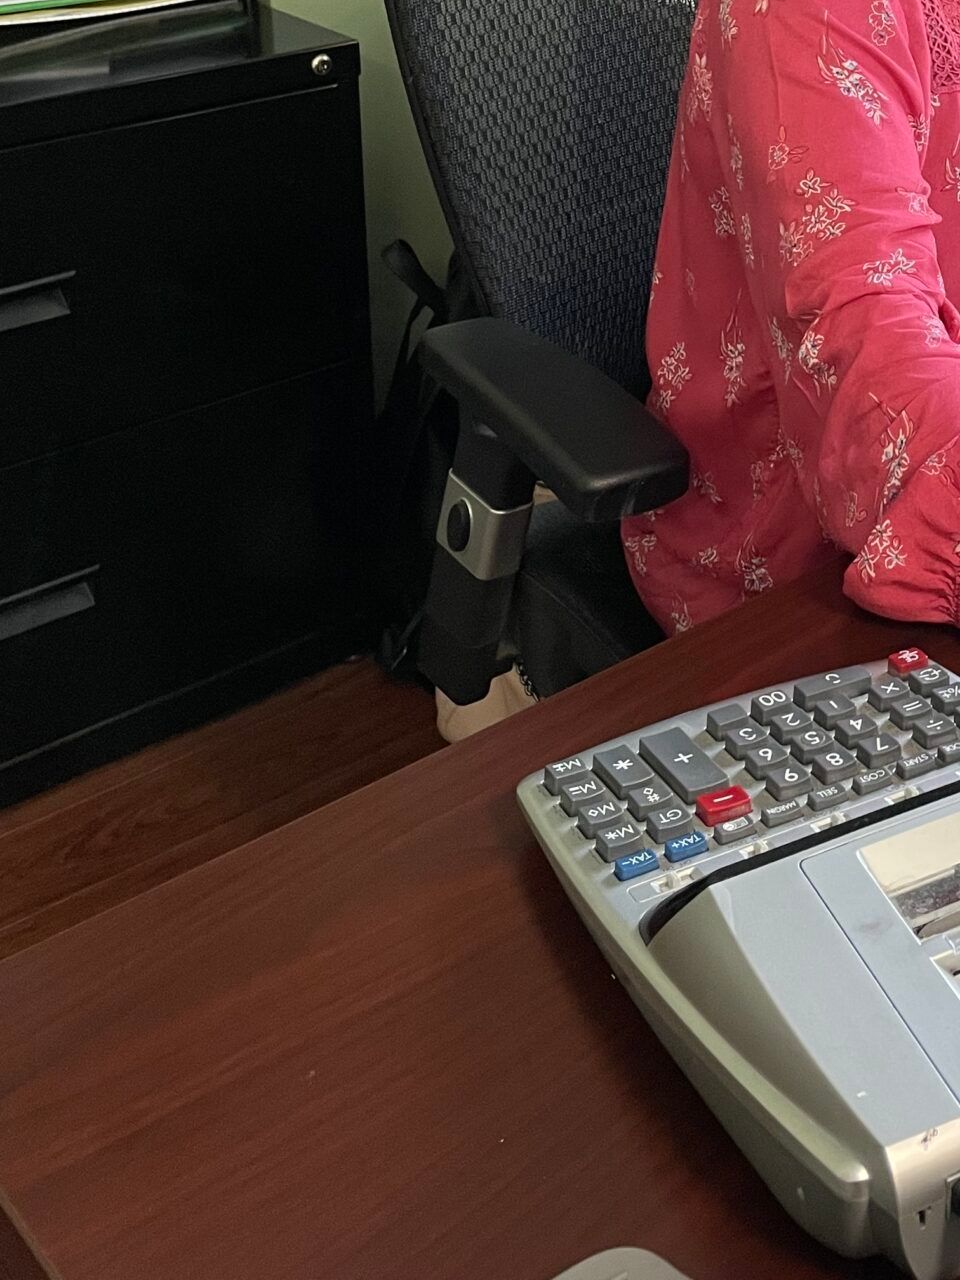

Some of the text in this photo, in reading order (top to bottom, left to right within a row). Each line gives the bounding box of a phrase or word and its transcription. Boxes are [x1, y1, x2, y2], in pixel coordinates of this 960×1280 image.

[758, 691, 786, 706] 00
[781, 712, 799, 726] 2
[849, 718, 863, 731] 4
[738, 728, 756, 741] 3
[804, 731, 820, 745] 5
[876, 737, 889, 751] 7
[758, 748, 772, 761] 6
[825, 752, 843, 766] 8
[903, 753, 929, 767] START
[784, 769, 798, 782] 9
[859, 769, 885, 783] COST
[816, 786, 838, 798] SELL
[766, 800, 797, 814] MARGIN
[658, 809, 682, 824] GT
[671, 833, 702, 849] TAX+
[622, 851, 653, 865] TAX-
